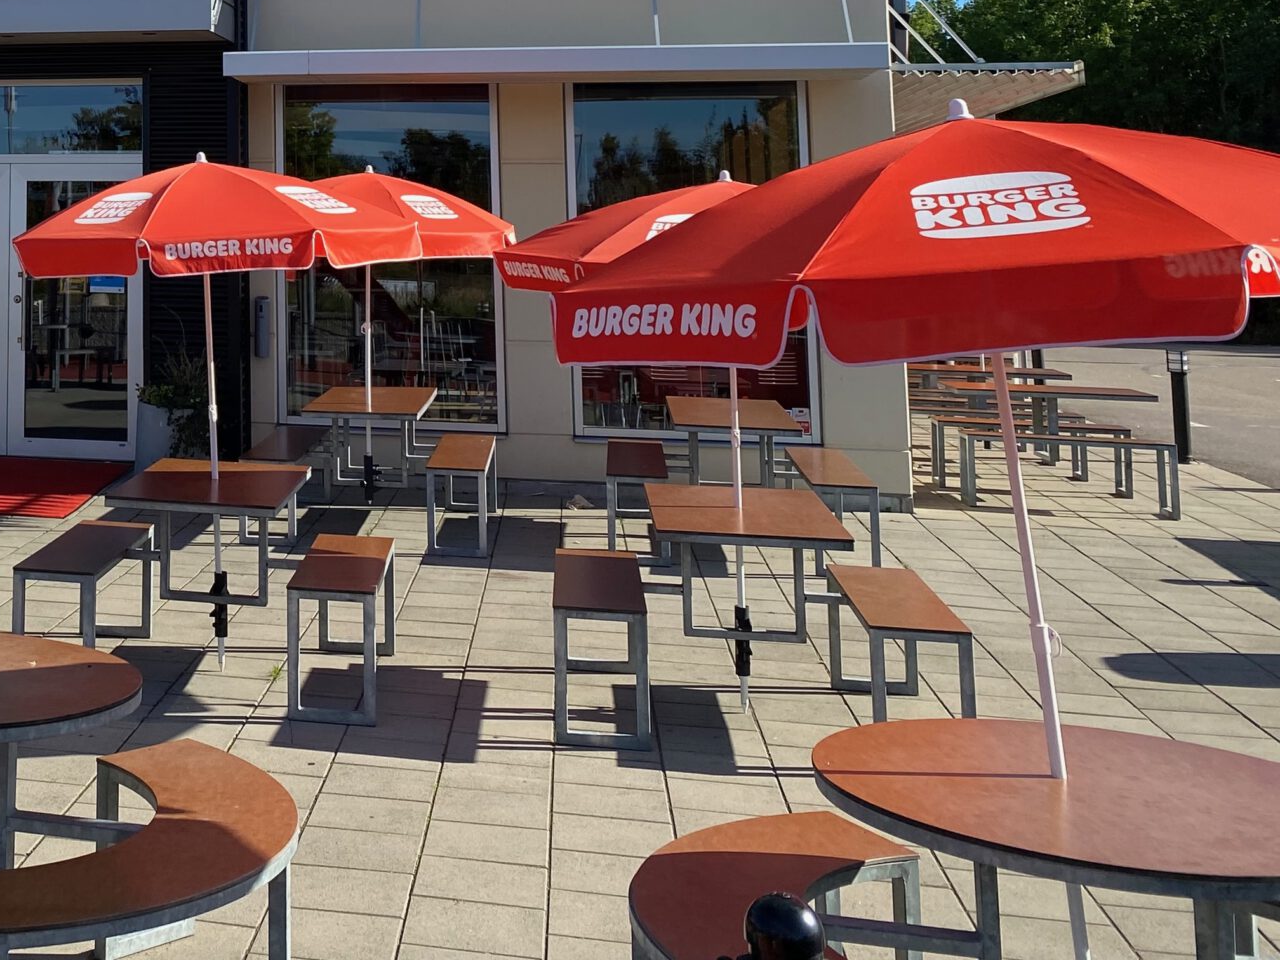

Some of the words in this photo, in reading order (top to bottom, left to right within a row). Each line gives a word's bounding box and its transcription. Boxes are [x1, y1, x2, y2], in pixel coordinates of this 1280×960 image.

[911, 183, 1079, 210] BURGER
[79, 206, 138, 219] KING
[915, 197, 1087, 230] KING
[164, 239, 241, 261] BURGER
[245, 237, 294, 255] KING
[503, 260, 544, 279] BURGER
[540, 265, 570, 283] KING
[572, 303, 674, 338] BURGER
[680, 303, 757, 338] KING
